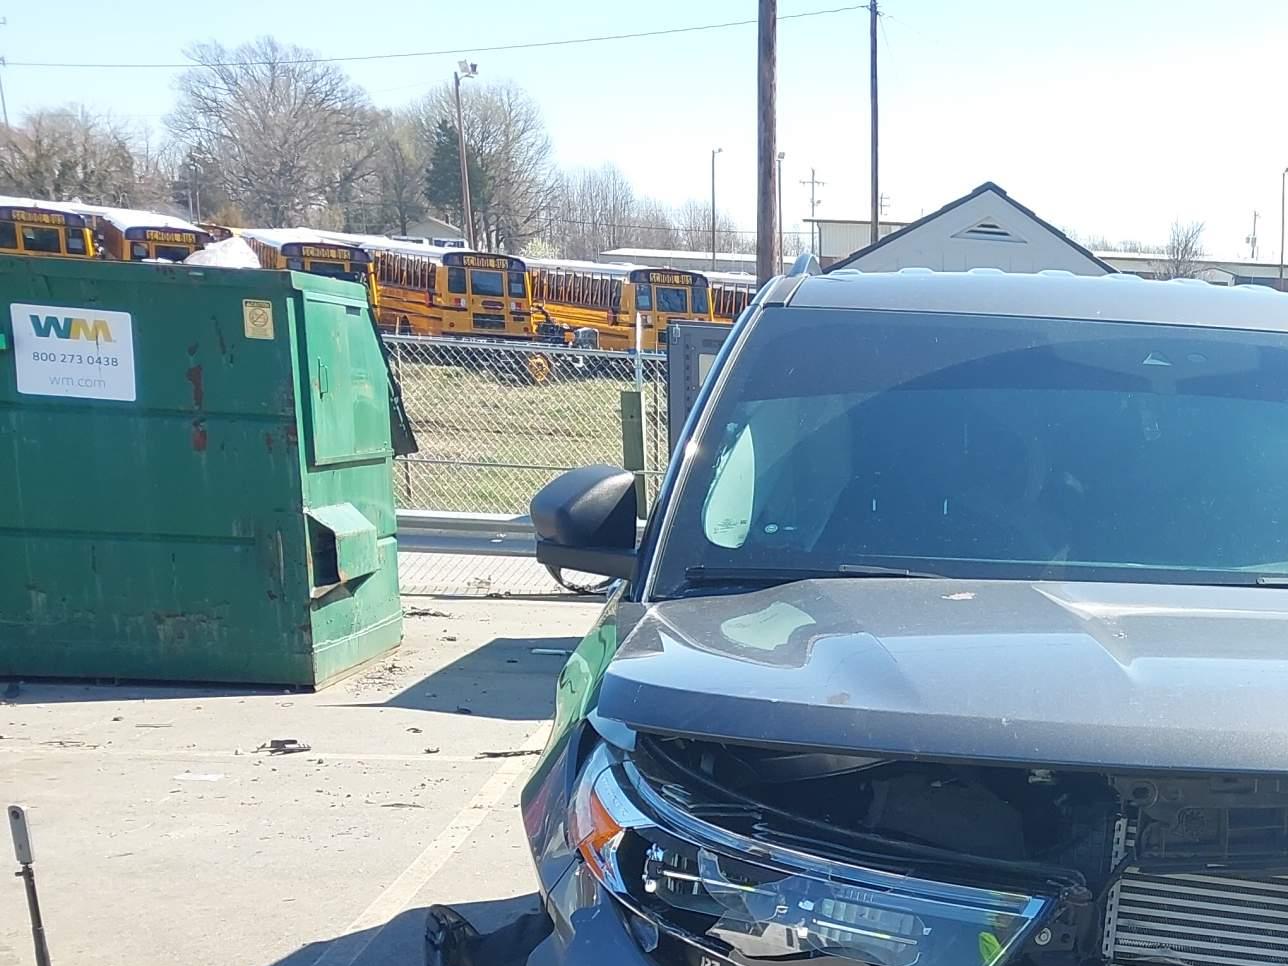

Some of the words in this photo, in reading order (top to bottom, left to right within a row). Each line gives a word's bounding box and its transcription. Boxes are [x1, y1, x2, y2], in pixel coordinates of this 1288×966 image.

[29, 314, 113, 343] WM
[32, 351, 57, 362] 800
[60, 354, 83, 364] 273
[87, 355, 119, 367] 0438
